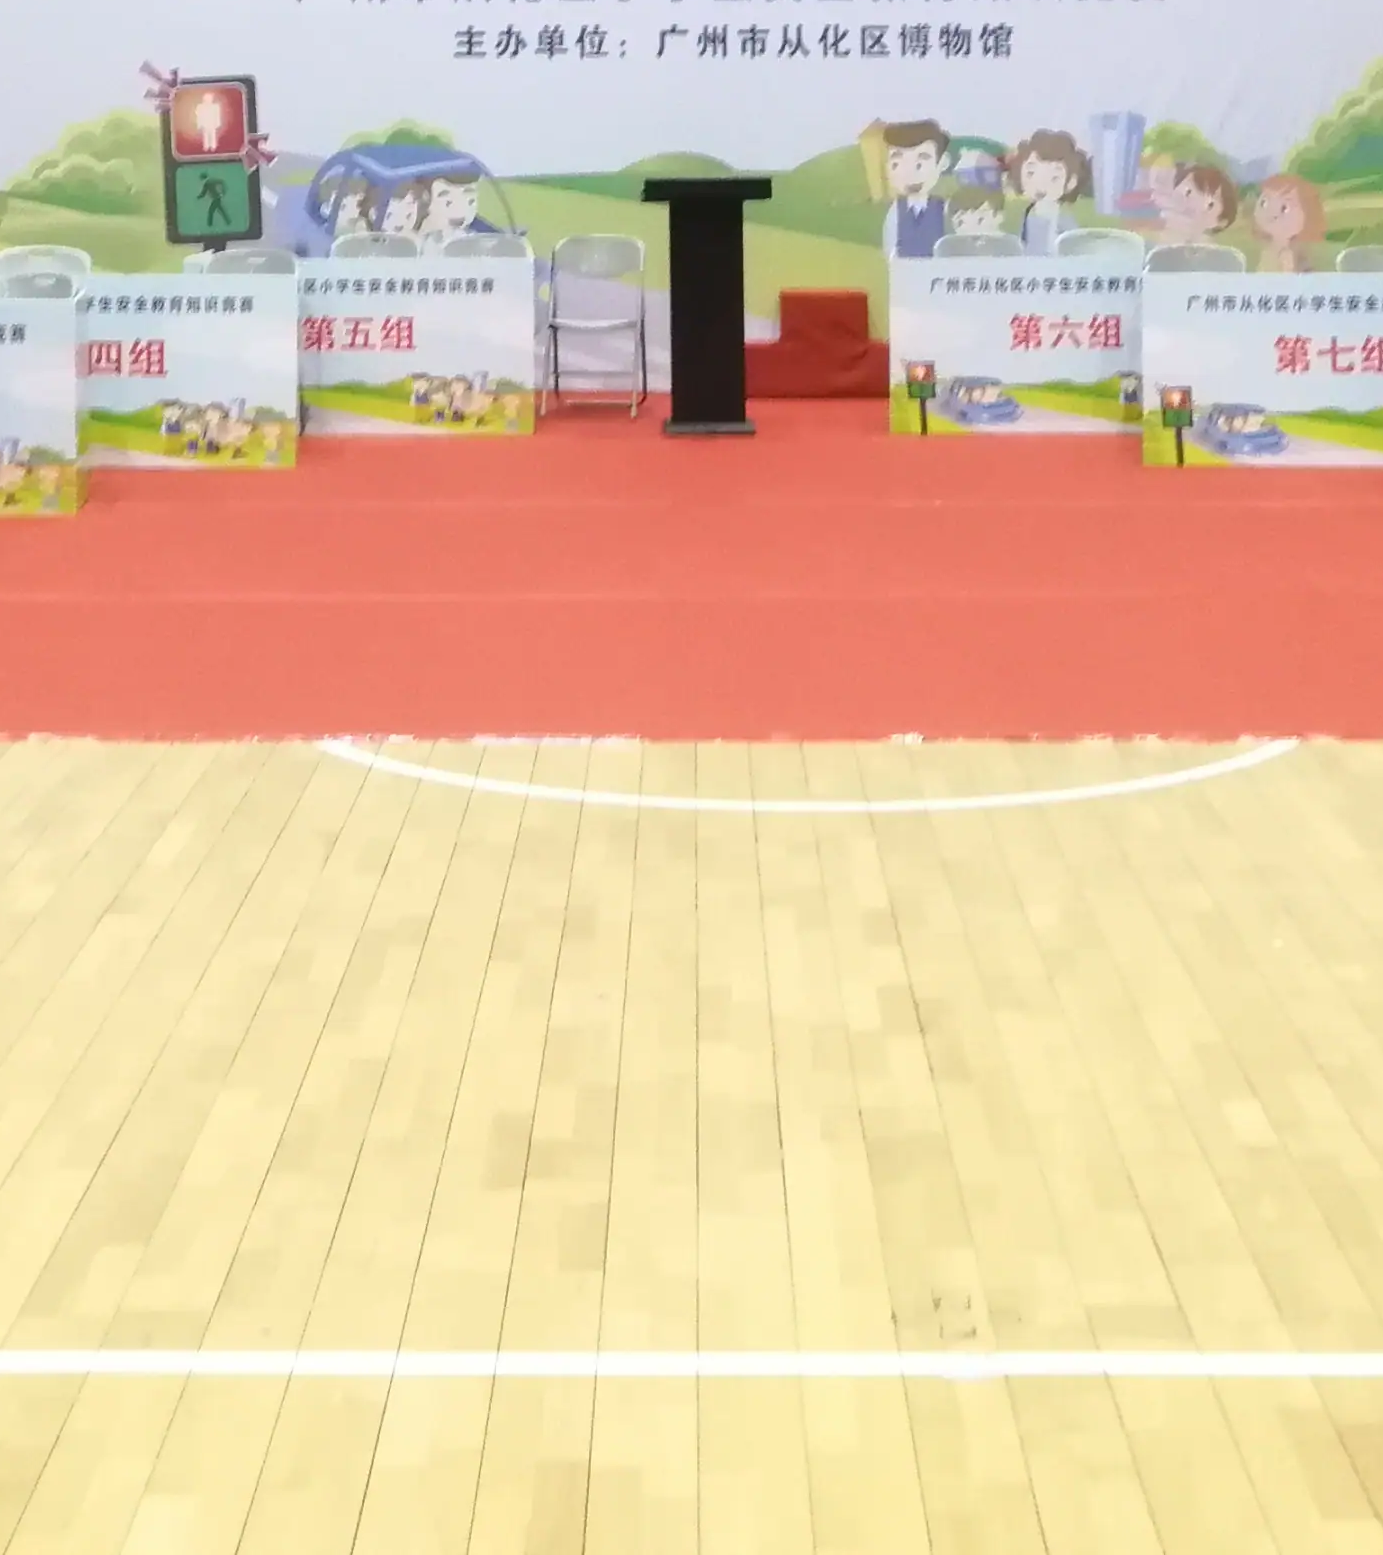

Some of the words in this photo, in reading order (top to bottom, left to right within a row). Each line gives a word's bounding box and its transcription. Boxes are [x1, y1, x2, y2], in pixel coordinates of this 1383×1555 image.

[453, 23, 1014, 59] 主办单位：广州市从化区博物馆
[297, 278, 494, 294] 区小学生安全教育知识竞赛
[930, 276, 1143, 294] 广州市从化区小学生安全教育
[301, 315, 417, 352] 第五组
[1010, 313, 1124, 351] 第六组
